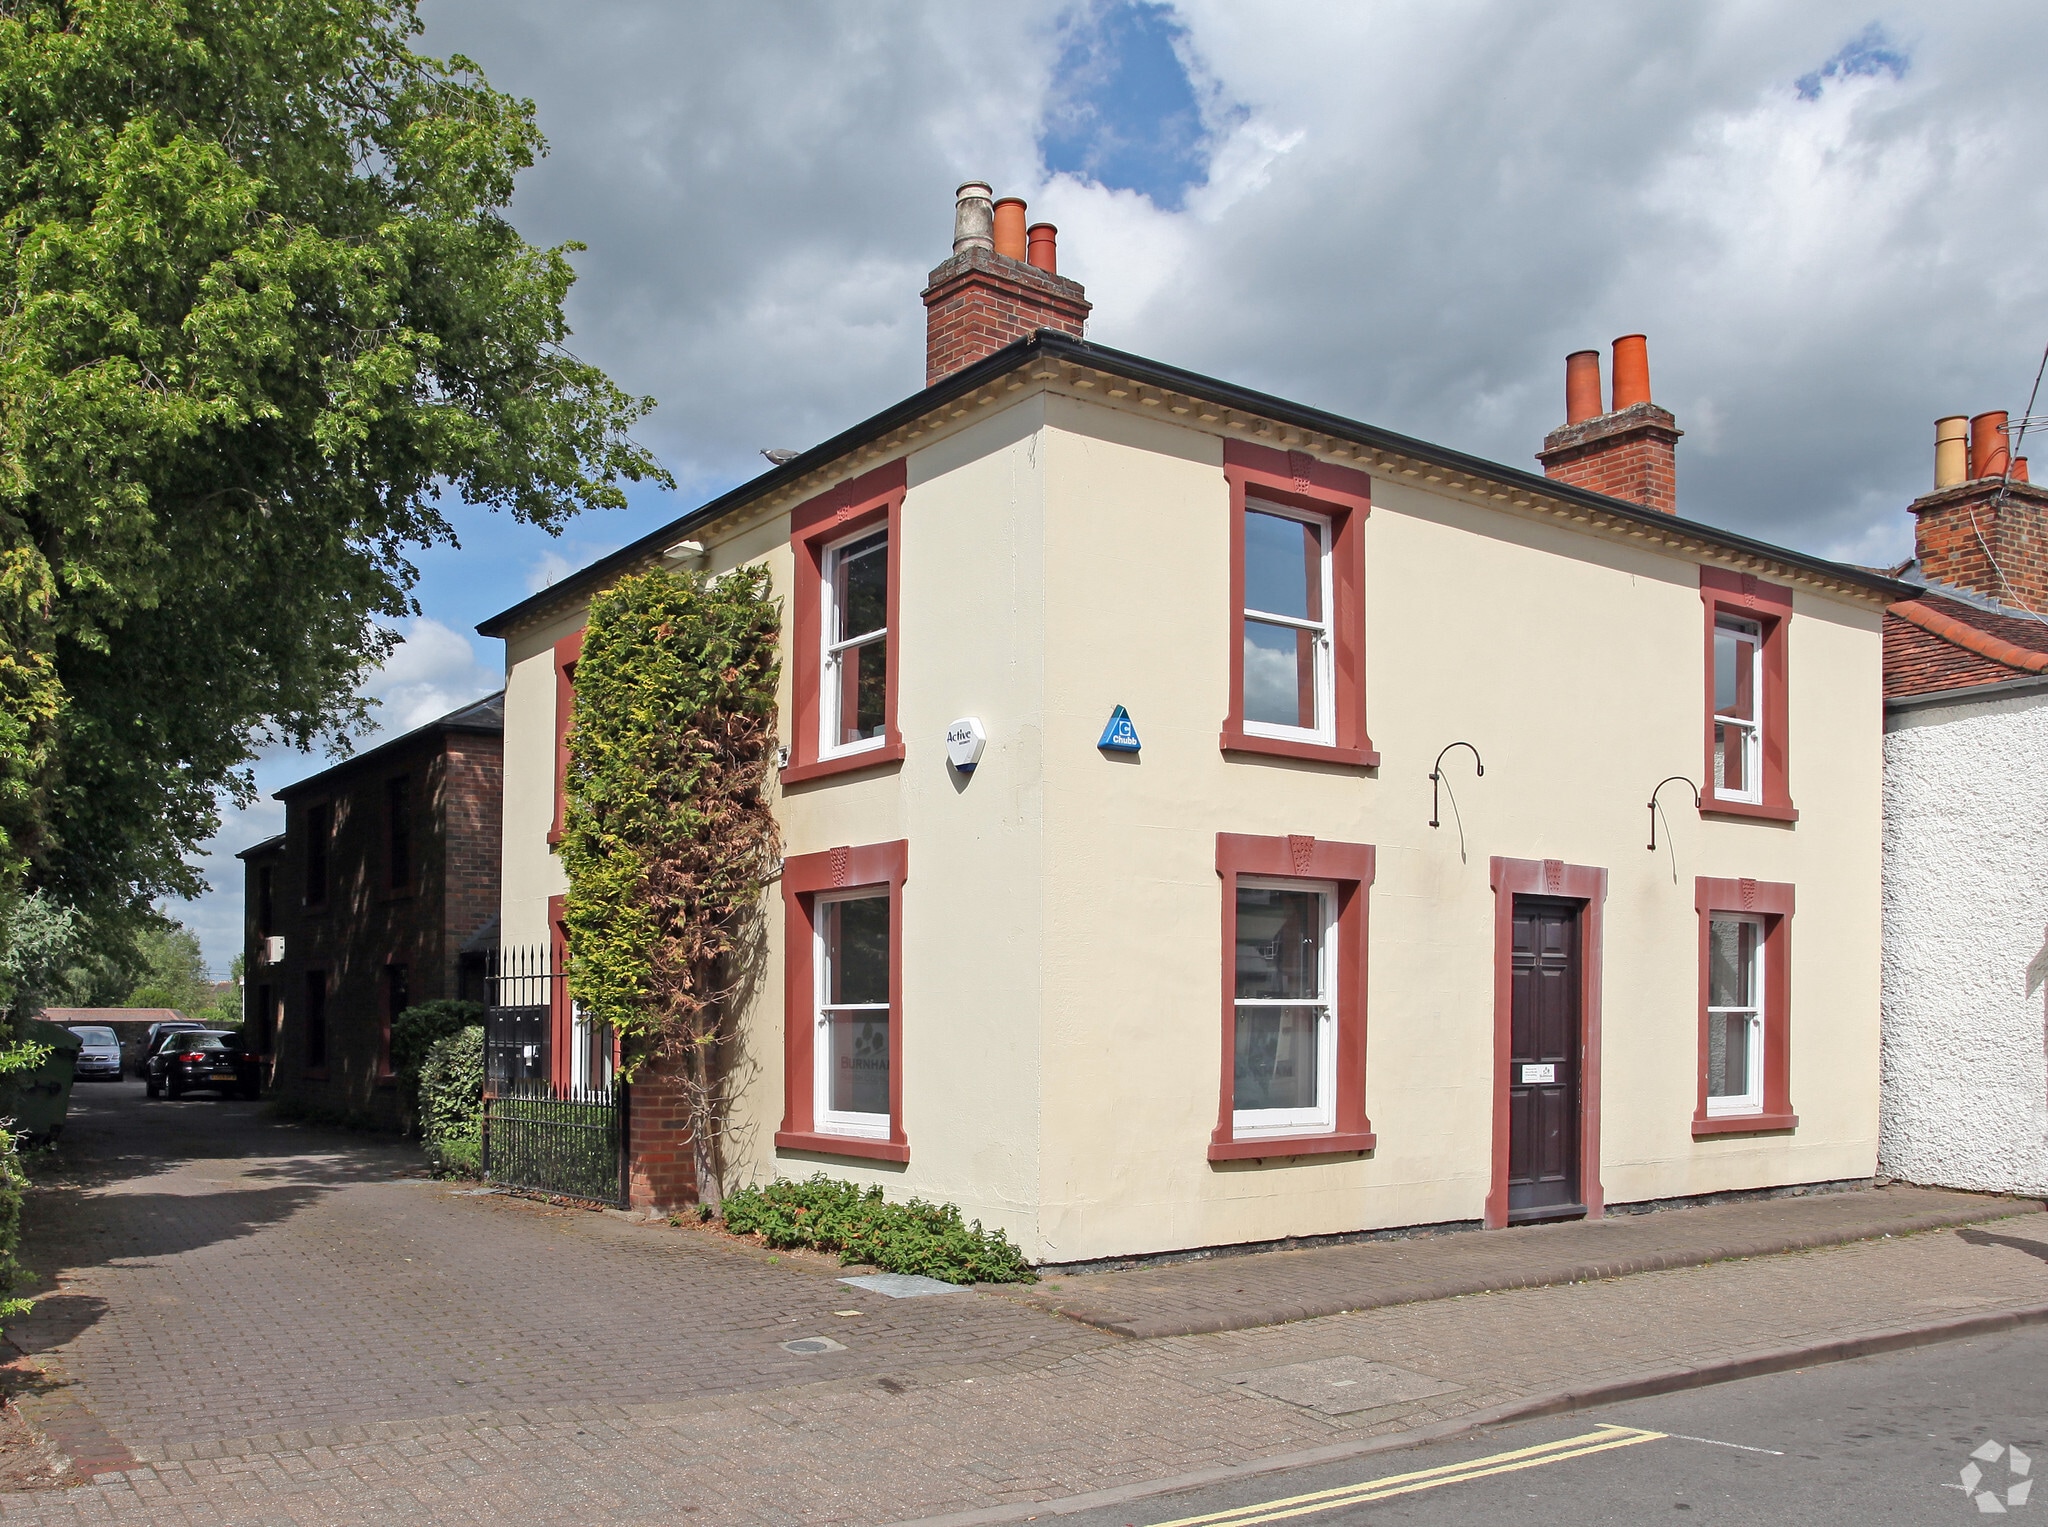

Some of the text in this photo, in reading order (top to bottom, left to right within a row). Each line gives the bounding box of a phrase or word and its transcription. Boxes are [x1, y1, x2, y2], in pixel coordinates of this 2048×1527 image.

[946, 729, 971, 743] Active
[1112, 735, 1137, 745] Chubb
[841, 1056, 889, 1070] BURNHA
